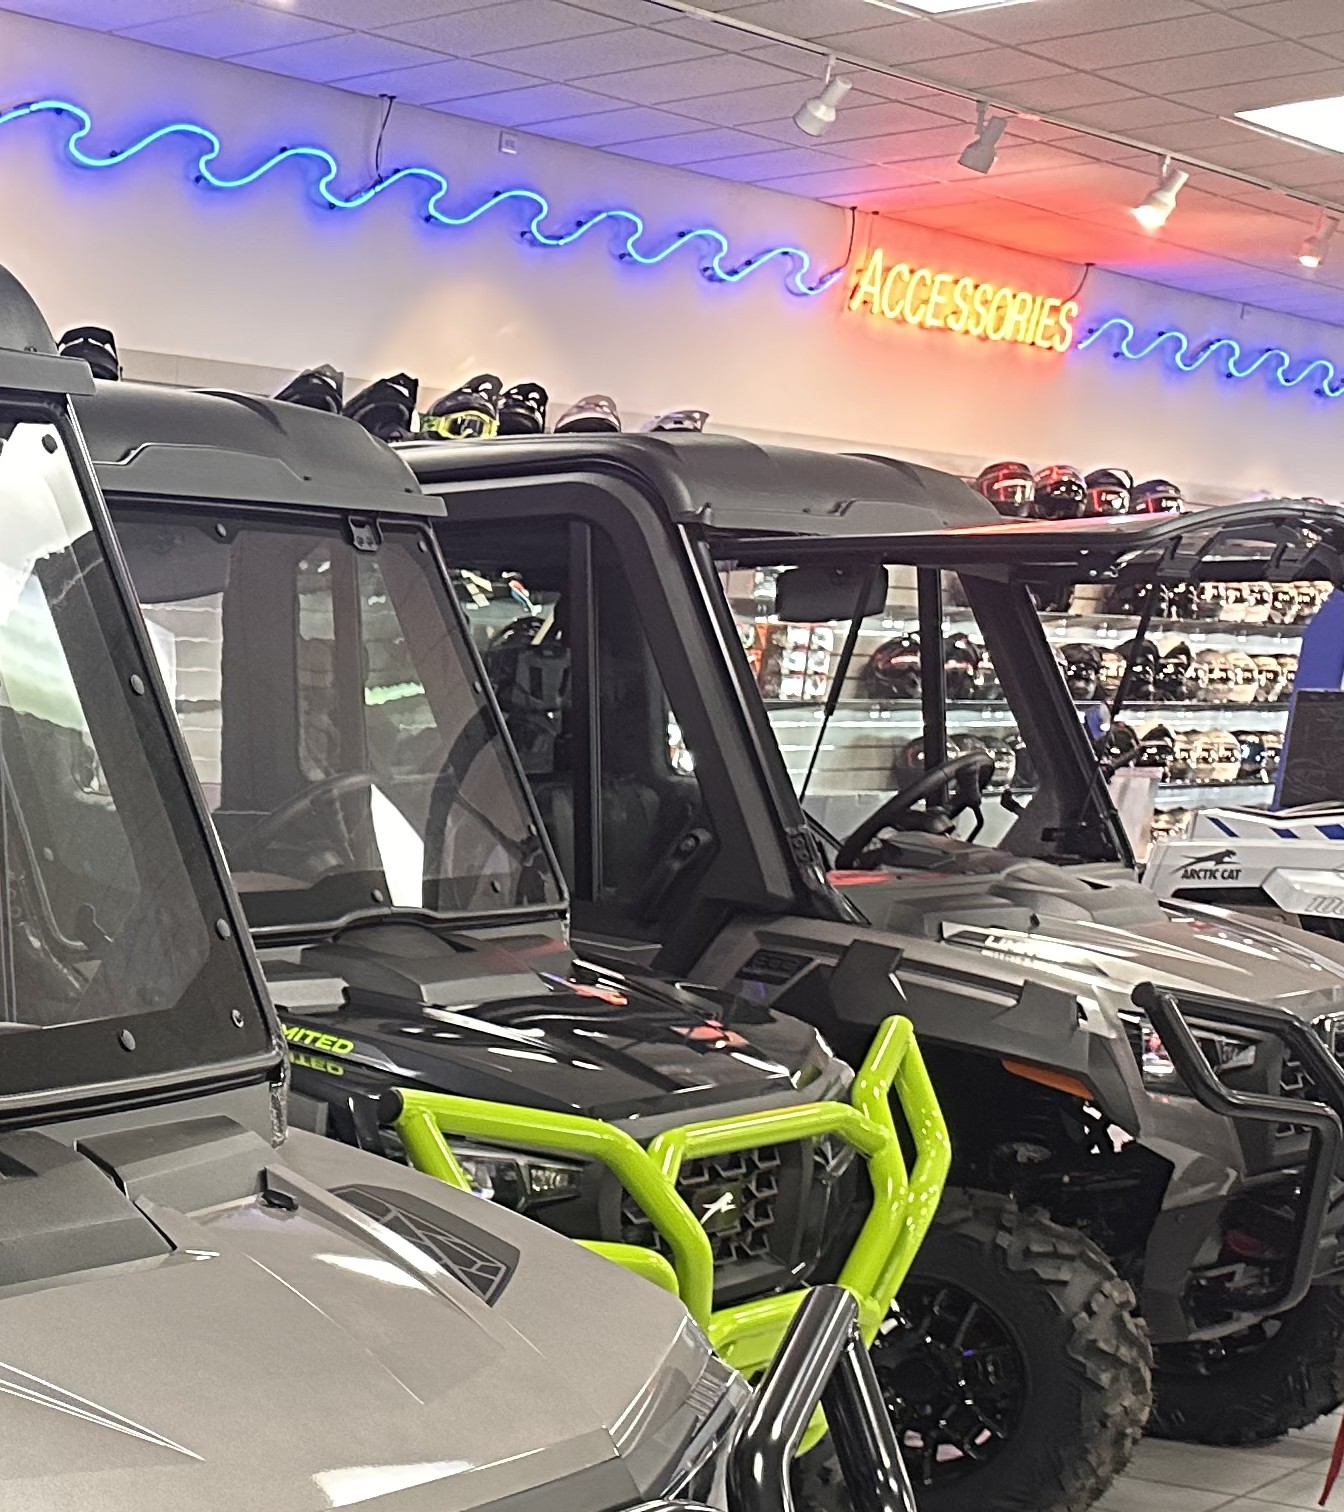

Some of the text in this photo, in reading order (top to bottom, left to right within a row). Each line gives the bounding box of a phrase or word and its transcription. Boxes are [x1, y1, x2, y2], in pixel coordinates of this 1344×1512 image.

[850, 247, 1079, 353] ACCESSORIES
[1181, 867, 1243, 881] ARCTIC CAT
[280, 1022, 356, 1055] MITED
